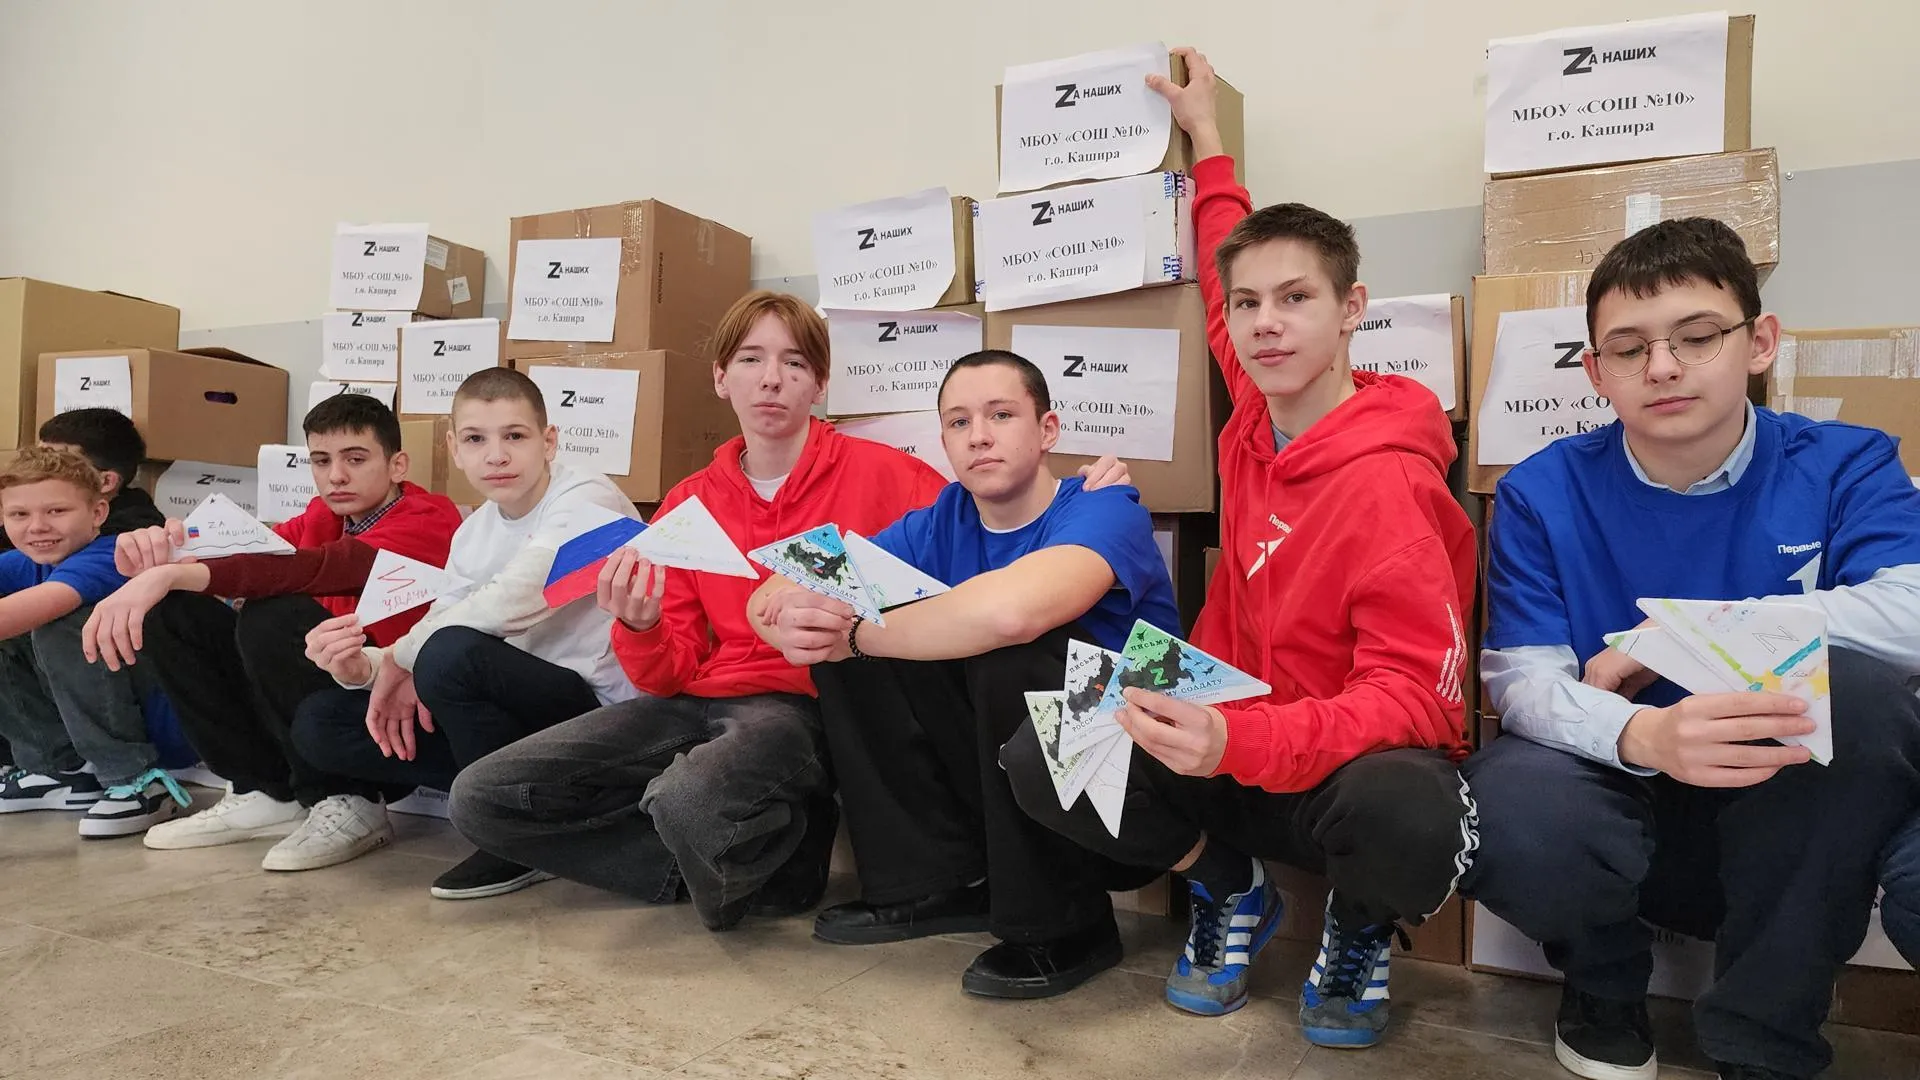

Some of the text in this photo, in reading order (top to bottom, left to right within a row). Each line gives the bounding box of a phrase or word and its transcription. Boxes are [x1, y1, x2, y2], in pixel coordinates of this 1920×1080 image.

[1602, 46, 1657, 64] НАШИХ
[1083, 84, 1122, 98] НАШИХ
[1511, 91, 1695, 123] МБОУ «СОШ №10»
[1020, 124, 1150, 149] МБОУ «СОШ №10»
[1547, 120, 1655, 142] г.о. Кашира
[1044, 150, 1120, 166] г.о. Кашира
[1058, 198, 1095, 215] НАШИХ
[880, 226, 912, 241] НАШИХ
[1002, 236, 1125, 268] МБОУ «СОШ №10»
[565, 266, 590, 274] НАШИХ
[832, 259, 938, 288] МБОУ «СОШ №10»
[1027, 263, 1099, 284] г.о. Кашира
[854, 281, 916, 302] г.о. Кашира
[524, 297, 549, 307] МБОУ
[552, 313, 585, 326] Кашира
[1354, 318, 1393, 332] АШИХ
[903, 323, 939, 335] НАШИХ
[1554, 341, 1586, 369] Z
[846, 359, 956, 377] МБОУ «СОШ №10
[1090, 362, 1128, 374] НАШИХ
[1384, 359, 1428, 373] №10»
[870, 381, 938, 393] г.о. Кашира
[579, 396, 605, 405] НАШИХ
[1050, 399, 1154, 416] ОУ «СОШ №10»
[1504, 396, 1611, 413] МБОУ «СО
[595, 428, 620, 439] №10»
[1074, 421, 1125, 437] Кашира
[1541, 424, 1569, 436] г.о.
[565, 443, 600, 456] Кашира
[1777, 541, 1822, 555] Первые
[1130, 638, 1169, 651] ПИСЬМО
[1069, 652, 1100, 674] ПИСЬМО
[1150, 667, 1169, 686] Z
[1180, 678, 1222, 695] СОЛДАТУ
